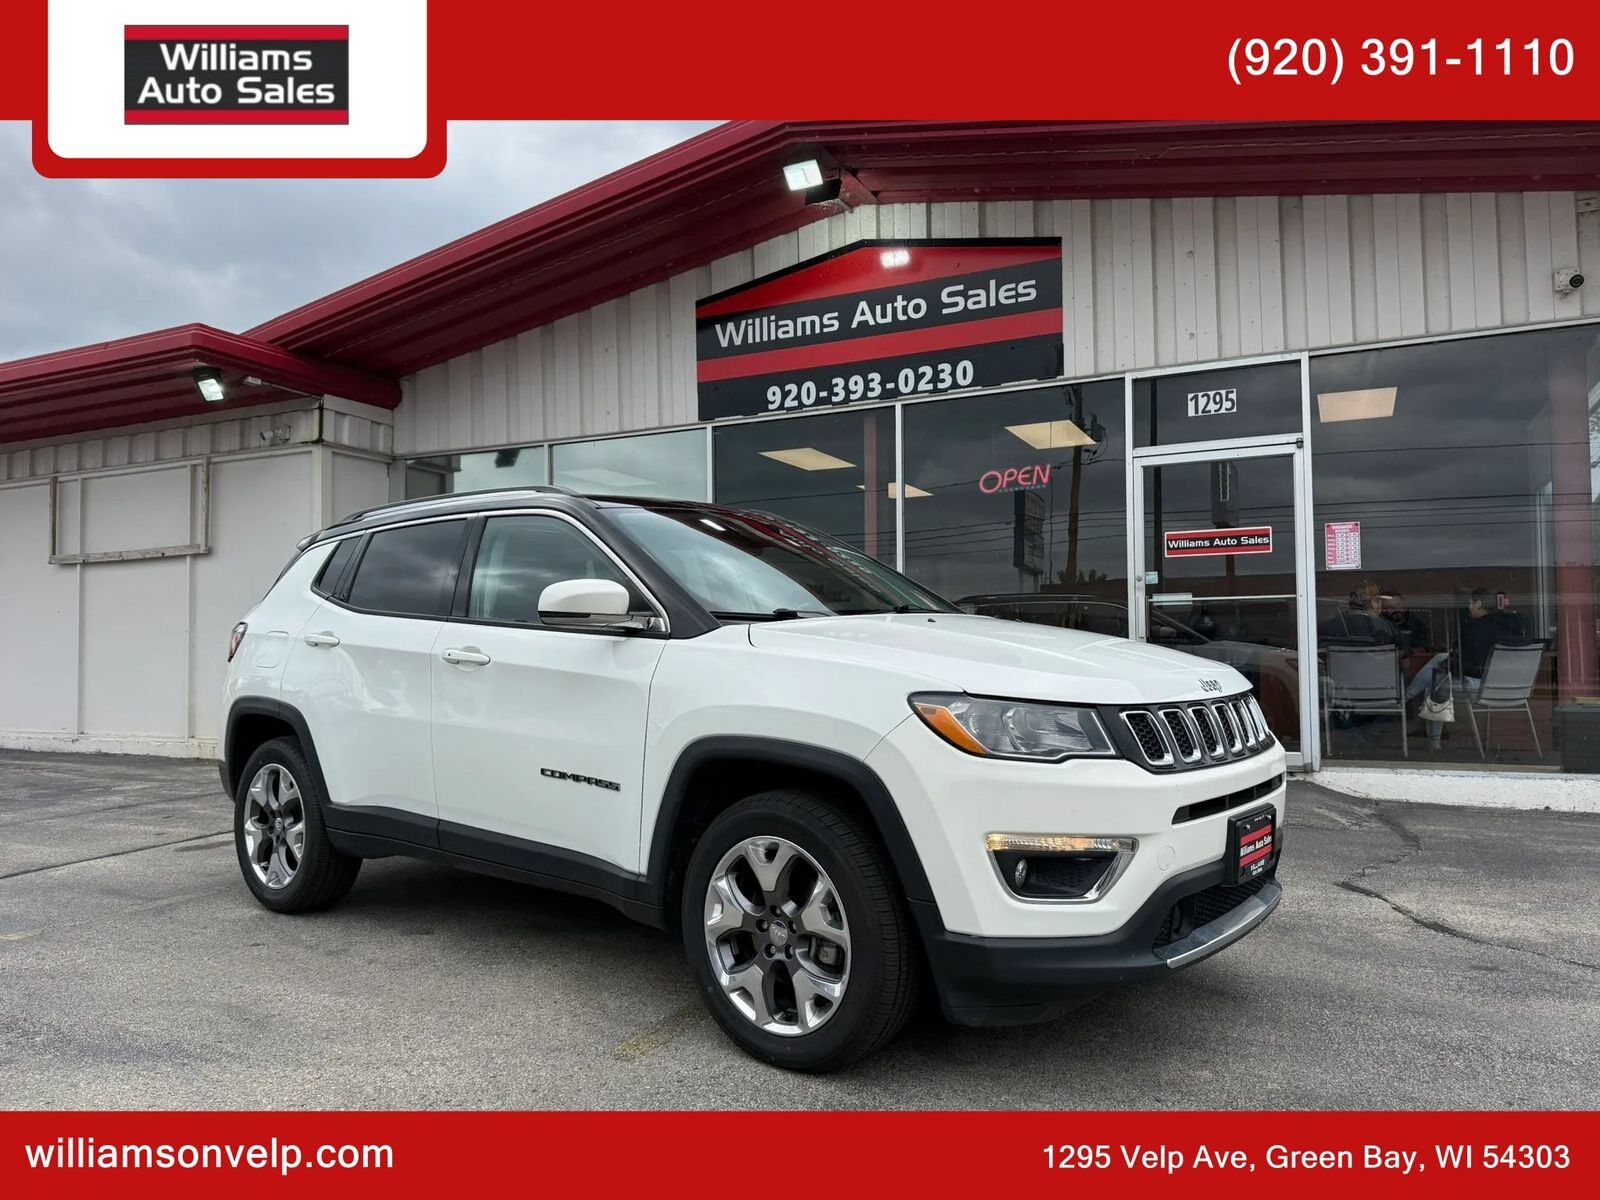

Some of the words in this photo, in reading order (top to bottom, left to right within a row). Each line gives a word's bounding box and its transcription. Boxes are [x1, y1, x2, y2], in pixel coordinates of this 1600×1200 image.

[715, 311, 840, 349] Williams
[851, 293, 927, 329] Auto
[940, 279, 1037, 315] Sales
[766, 360, 975, 411] 920-393-0230
[1188, 389, 1236, 415] 1295
[979, 464, 1051, 494] OPEN
[1167, 539, 1210, 549] Williams
[1213, 538, 1238, 546] Auto
[1240, 536, 1270, 545] Sales
[540, 767, 621, 792] COMPASS
